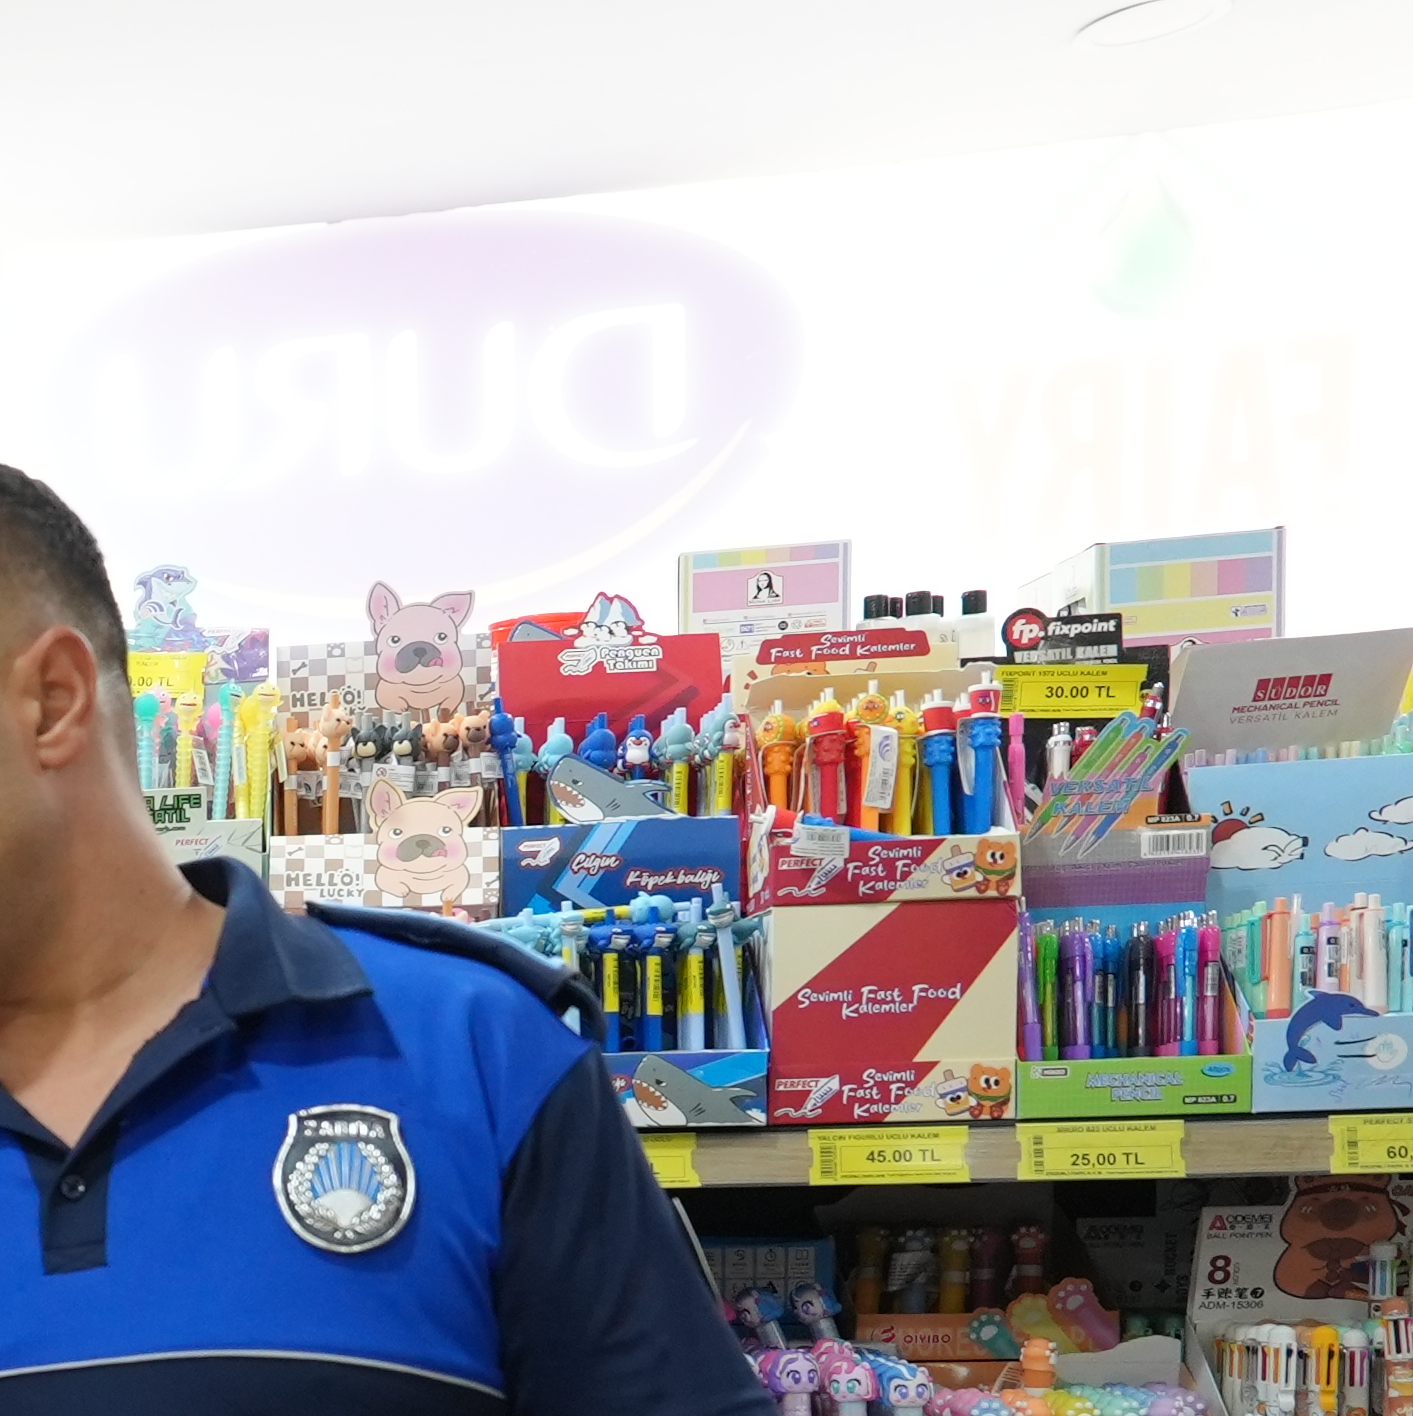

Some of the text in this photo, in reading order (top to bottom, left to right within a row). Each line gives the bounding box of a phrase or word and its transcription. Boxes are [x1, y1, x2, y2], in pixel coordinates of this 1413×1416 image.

[1047, 618, 1117, 637] fixpoint
[820, 633, 866, 648] Sevimli
[600, 647, 659, 659] Penguen
[770, 643, 916, 662] Fast Food Kalemler
[159, 676, 174, 687] TL
[291, 688, 363, 708] HELO!
[1045, 685, 1116, 699] 30.00 TL
[1232, 698, 1341, 714] MECHANICAL PENCIL
[1294, 709, 1339, 719] KALEM
[161, 794, 202, 809] LIFE
[868, 845, 922, 865] Sevimli
[285, 869, 361, 888] HELLO!
[846, 861, 887, 882] Fast
[319, 888, 365, 898] LUCKY
[858, 878, 929, 897] Kalemler
[797, 983, 962, 1009] Sevimli Fast Food
[841, 1001, 915, 1020] Kalemler
[776, 1079, 821, 1090] PERFECT
[862, 1068, 915, 1088] Sevimli
[1085, 1070, 1184, 1088] MECHANICAL
[842, 1082, 938, 1105] Fast Food
[1110, 1085, 1165, 1102] PENCIL
[853, 1101, 923, 1119] Kalemler
[865, 1149, 941, 1163] 45.00 TL
[1070, 1152, 1145, 1168] 25,00 TL
[1208, 1255, 1232, 1285] 8
[903, 1331, 952, 1346] QIYIBO
